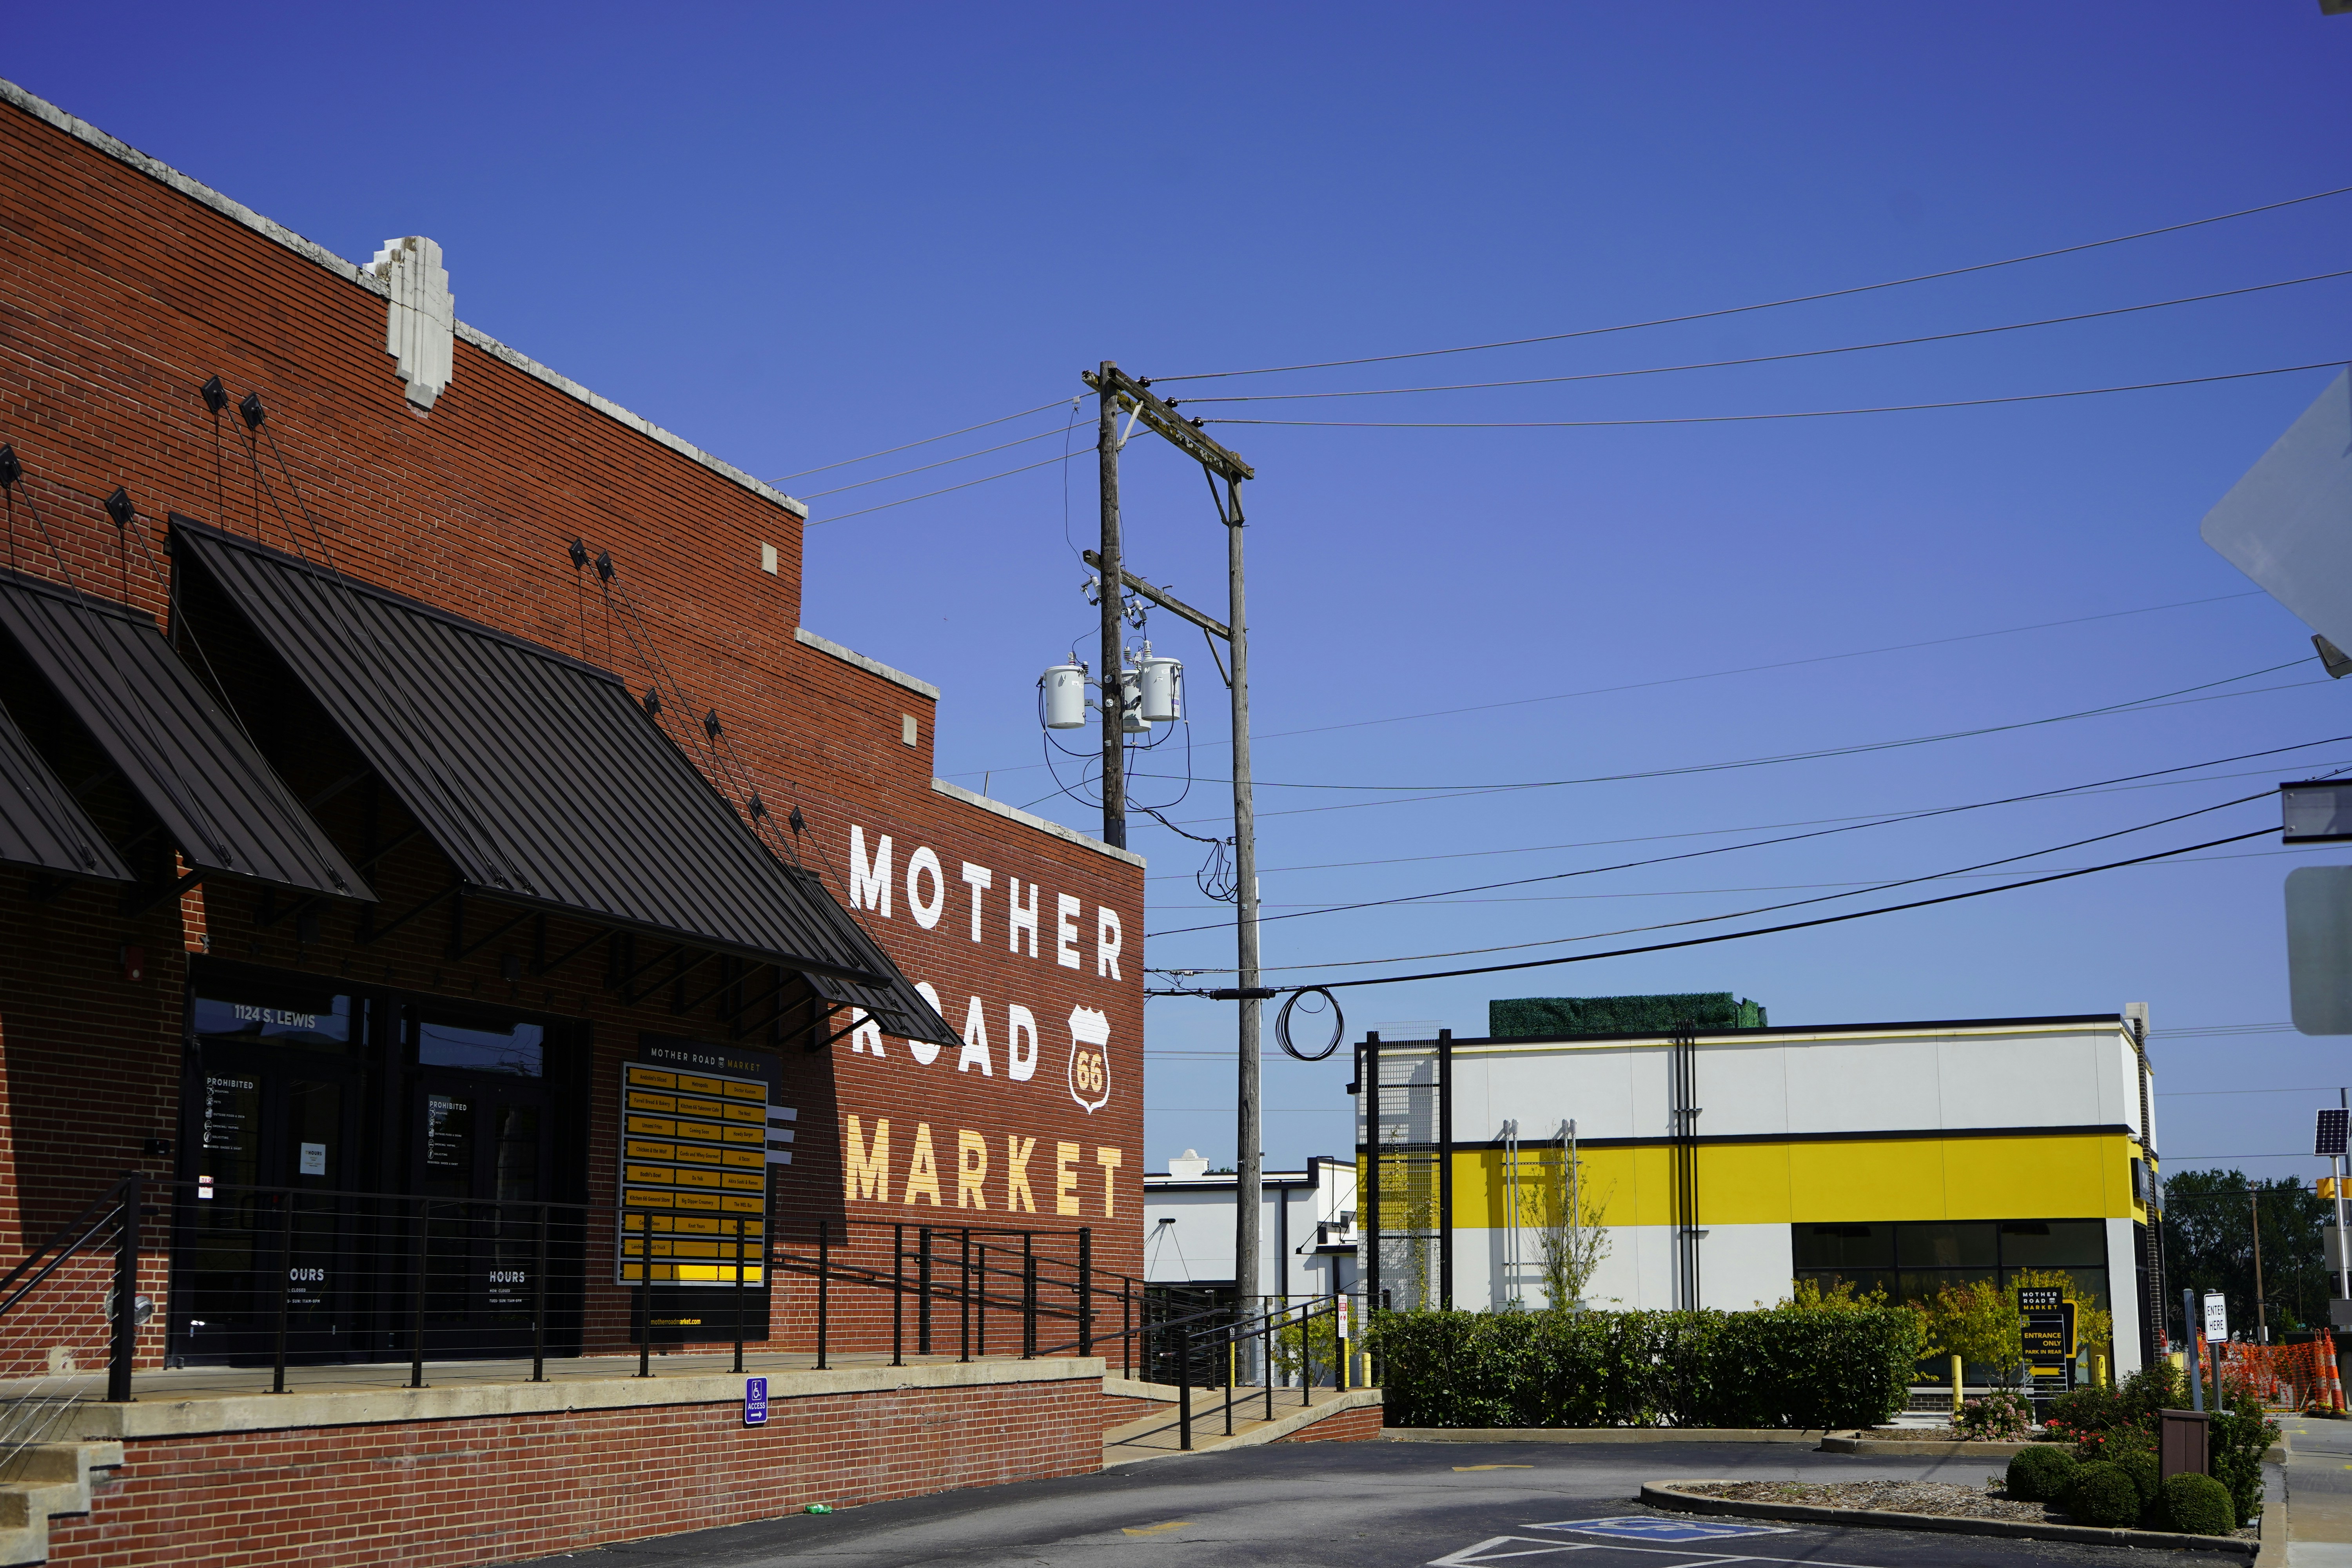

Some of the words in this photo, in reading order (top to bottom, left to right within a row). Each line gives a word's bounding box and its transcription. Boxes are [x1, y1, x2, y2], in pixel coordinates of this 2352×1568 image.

[850, 824, 1122, 981] MOTHER
[235, 1005, 260, 1021] 1124
[263, 1009, 274, 1023] S.
[277, 1011, 315, 1028] LEWIS
[651, 1047, 688, 1061] MOTHER
[693, 1054, 715, 1065] ROAD
[727, 1060, 760, 1072] MARKET
[1077, 1051, 1102, 1091] 66
[207, 1077, 254, 1089] PROHIBITED
[430, 1101, 467, 1111] PROHIBITED
[843, 1114, 1122, 1218] MARKET
[290, 1268, 324, 1281] OURS
[490, 1271, 525, 1283] HOURS
[2207, 1305, 2224, 1316] ENTER
[2209, 1320, 2223, 1330] HERE
[748, 1402, 765, 1410] ACCESS
